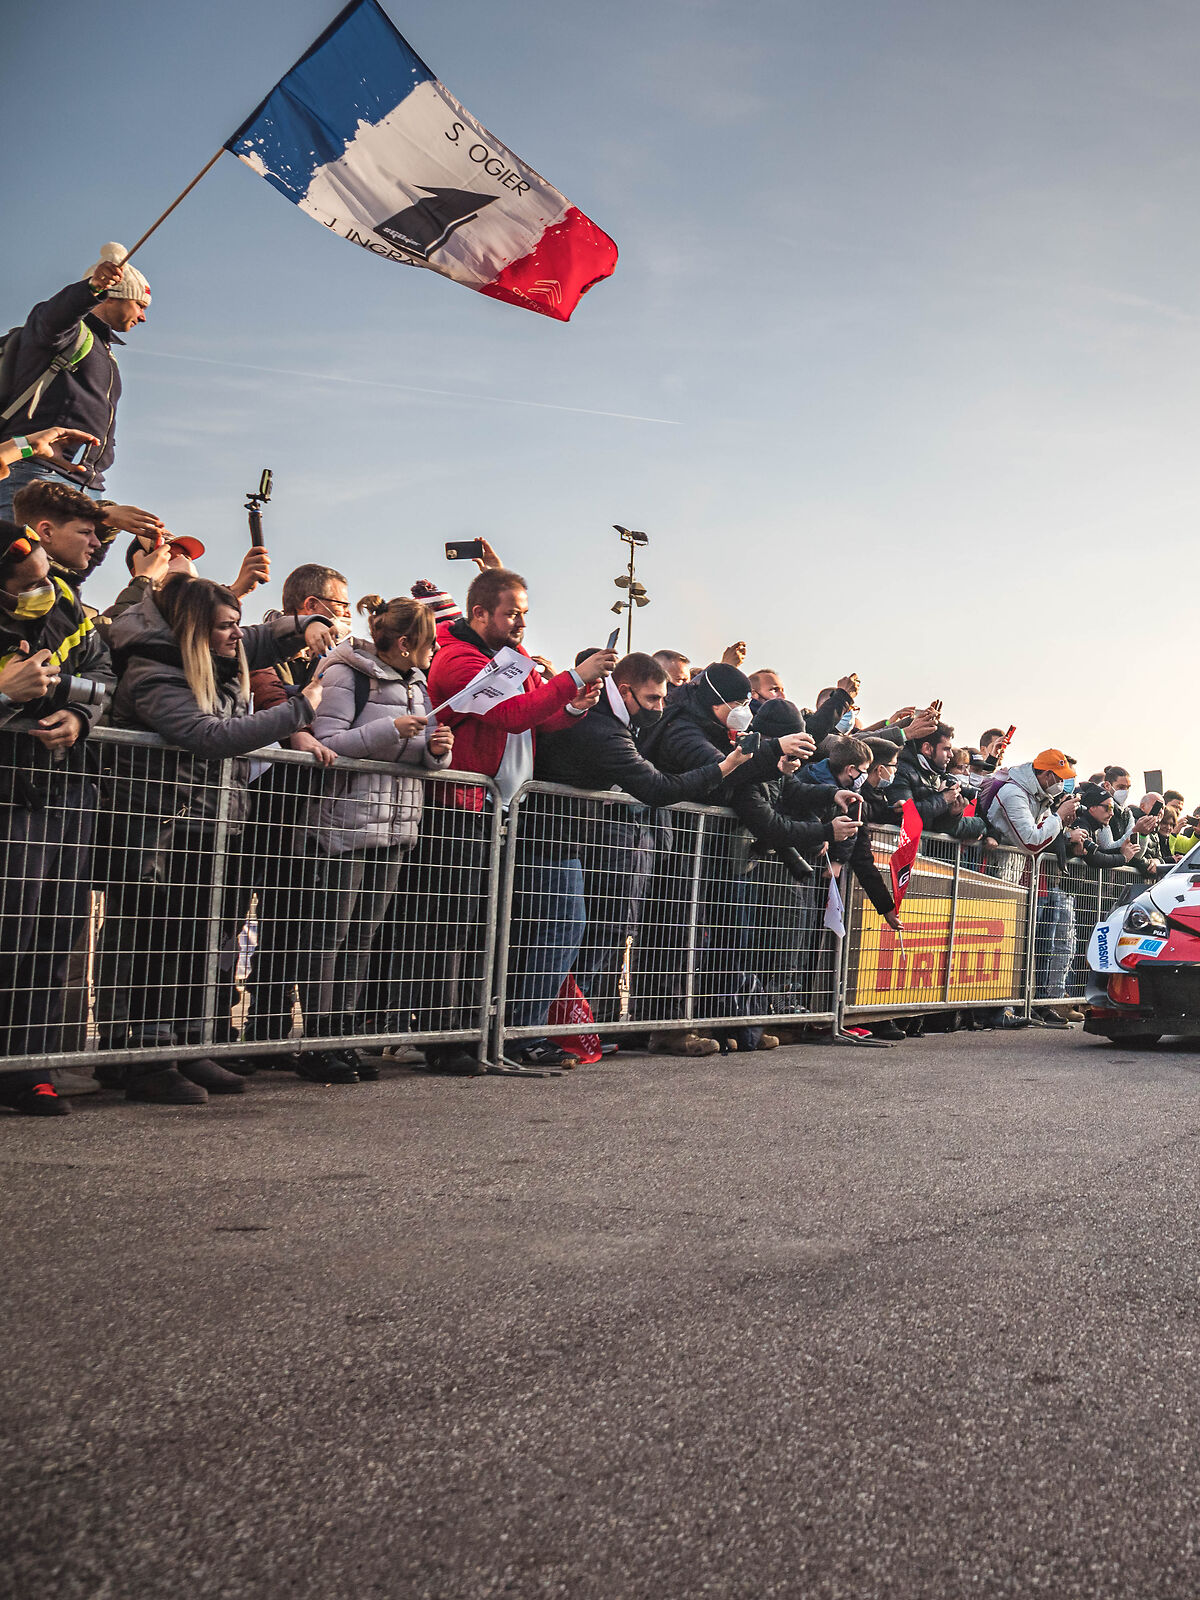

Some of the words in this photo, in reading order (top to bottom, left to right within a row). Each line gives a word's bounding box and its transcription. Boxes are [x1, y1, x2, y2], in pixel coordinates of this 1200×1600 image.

[444, 122, 465, 147] S.
[468, 143, 531, 197] OGIER
[323, 218, 338, 232] J.
[1096, 925, 1113, 970] Panasonic
[1152, 929, 1166, 938] PIAA
[875, 920, 1005, 993] PIRELLI
